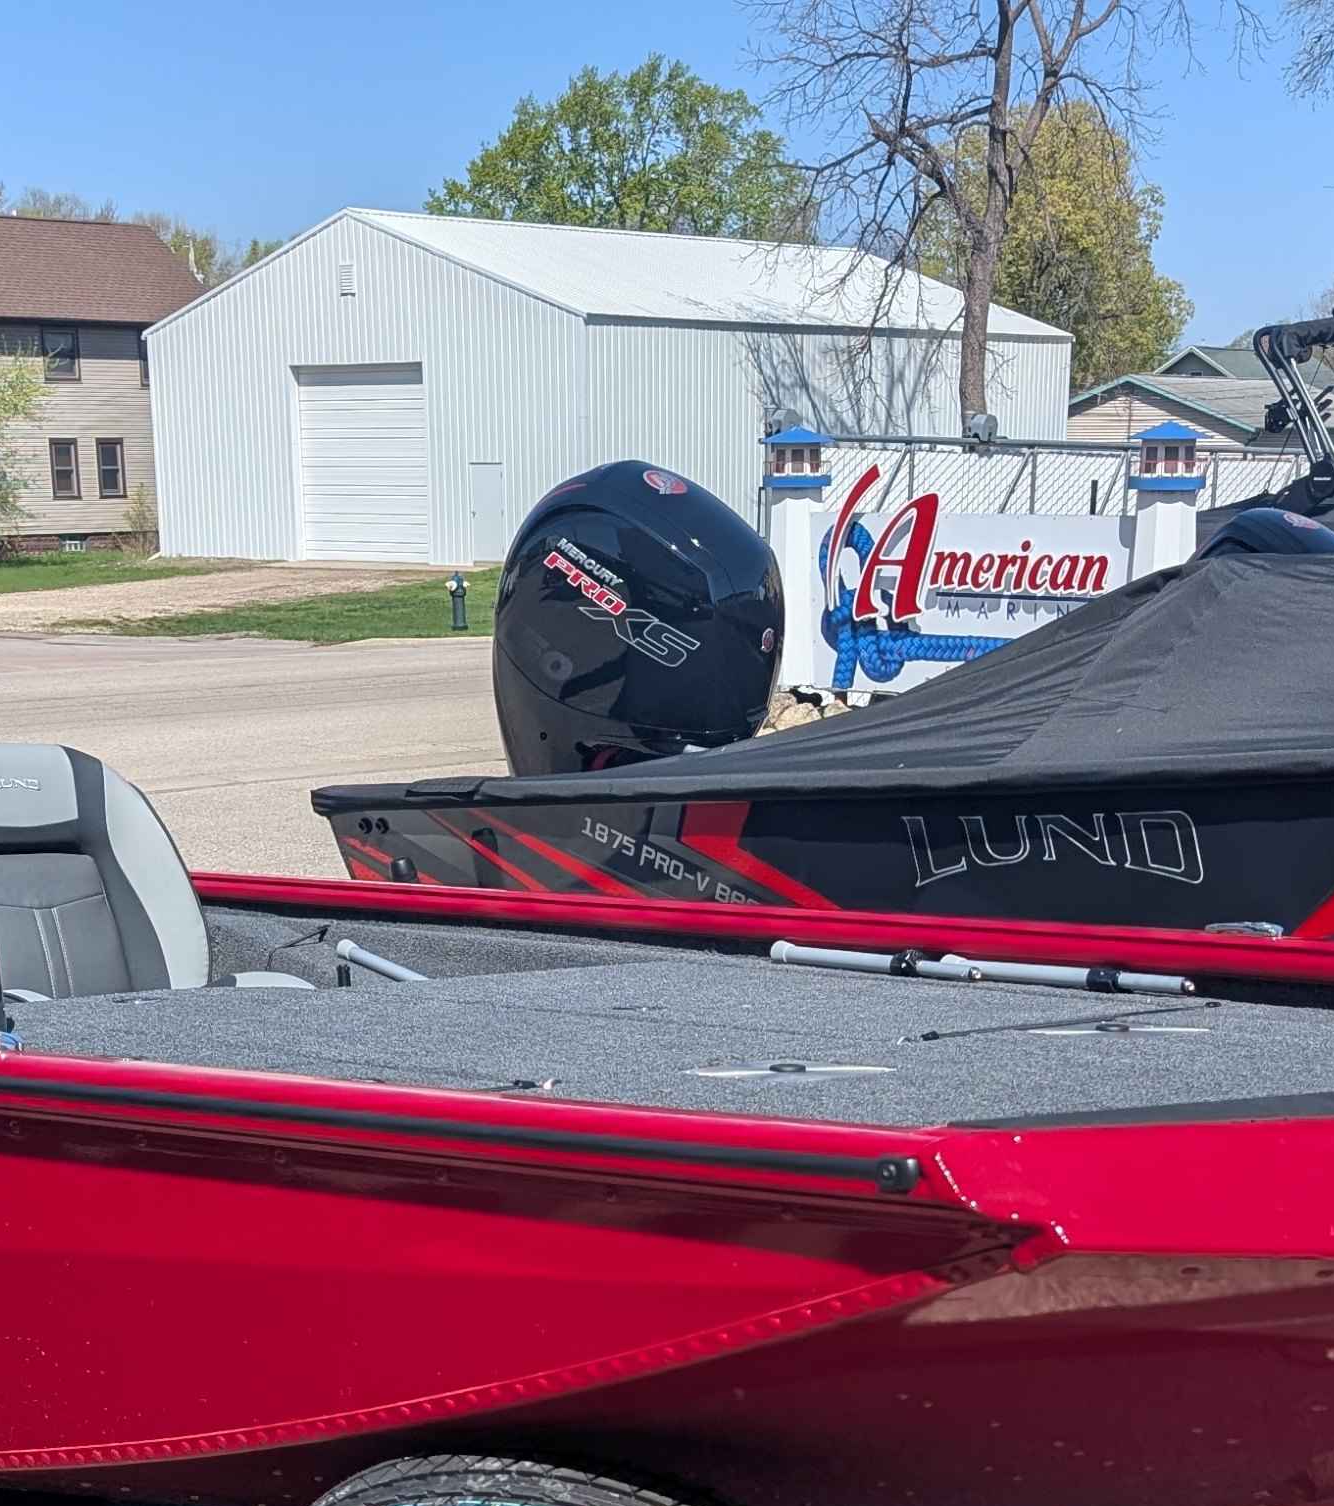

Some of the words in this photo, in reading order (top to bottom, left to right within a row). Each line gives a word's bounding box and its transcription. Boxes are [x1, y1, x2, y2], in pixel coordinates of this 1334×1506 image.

[556, 537, 624, 587] MERCURY
[837, 478, 1109, 621] American
[543, 551, 627, 616] PRO
[945, 601, 1070, 622] MARIN
[578, 606, 701, 668] XS
[581, 816, 638, 857] 1875
[638, 844, 711, 893] PRO-V
[900, 810, 1204, 888] LUND
